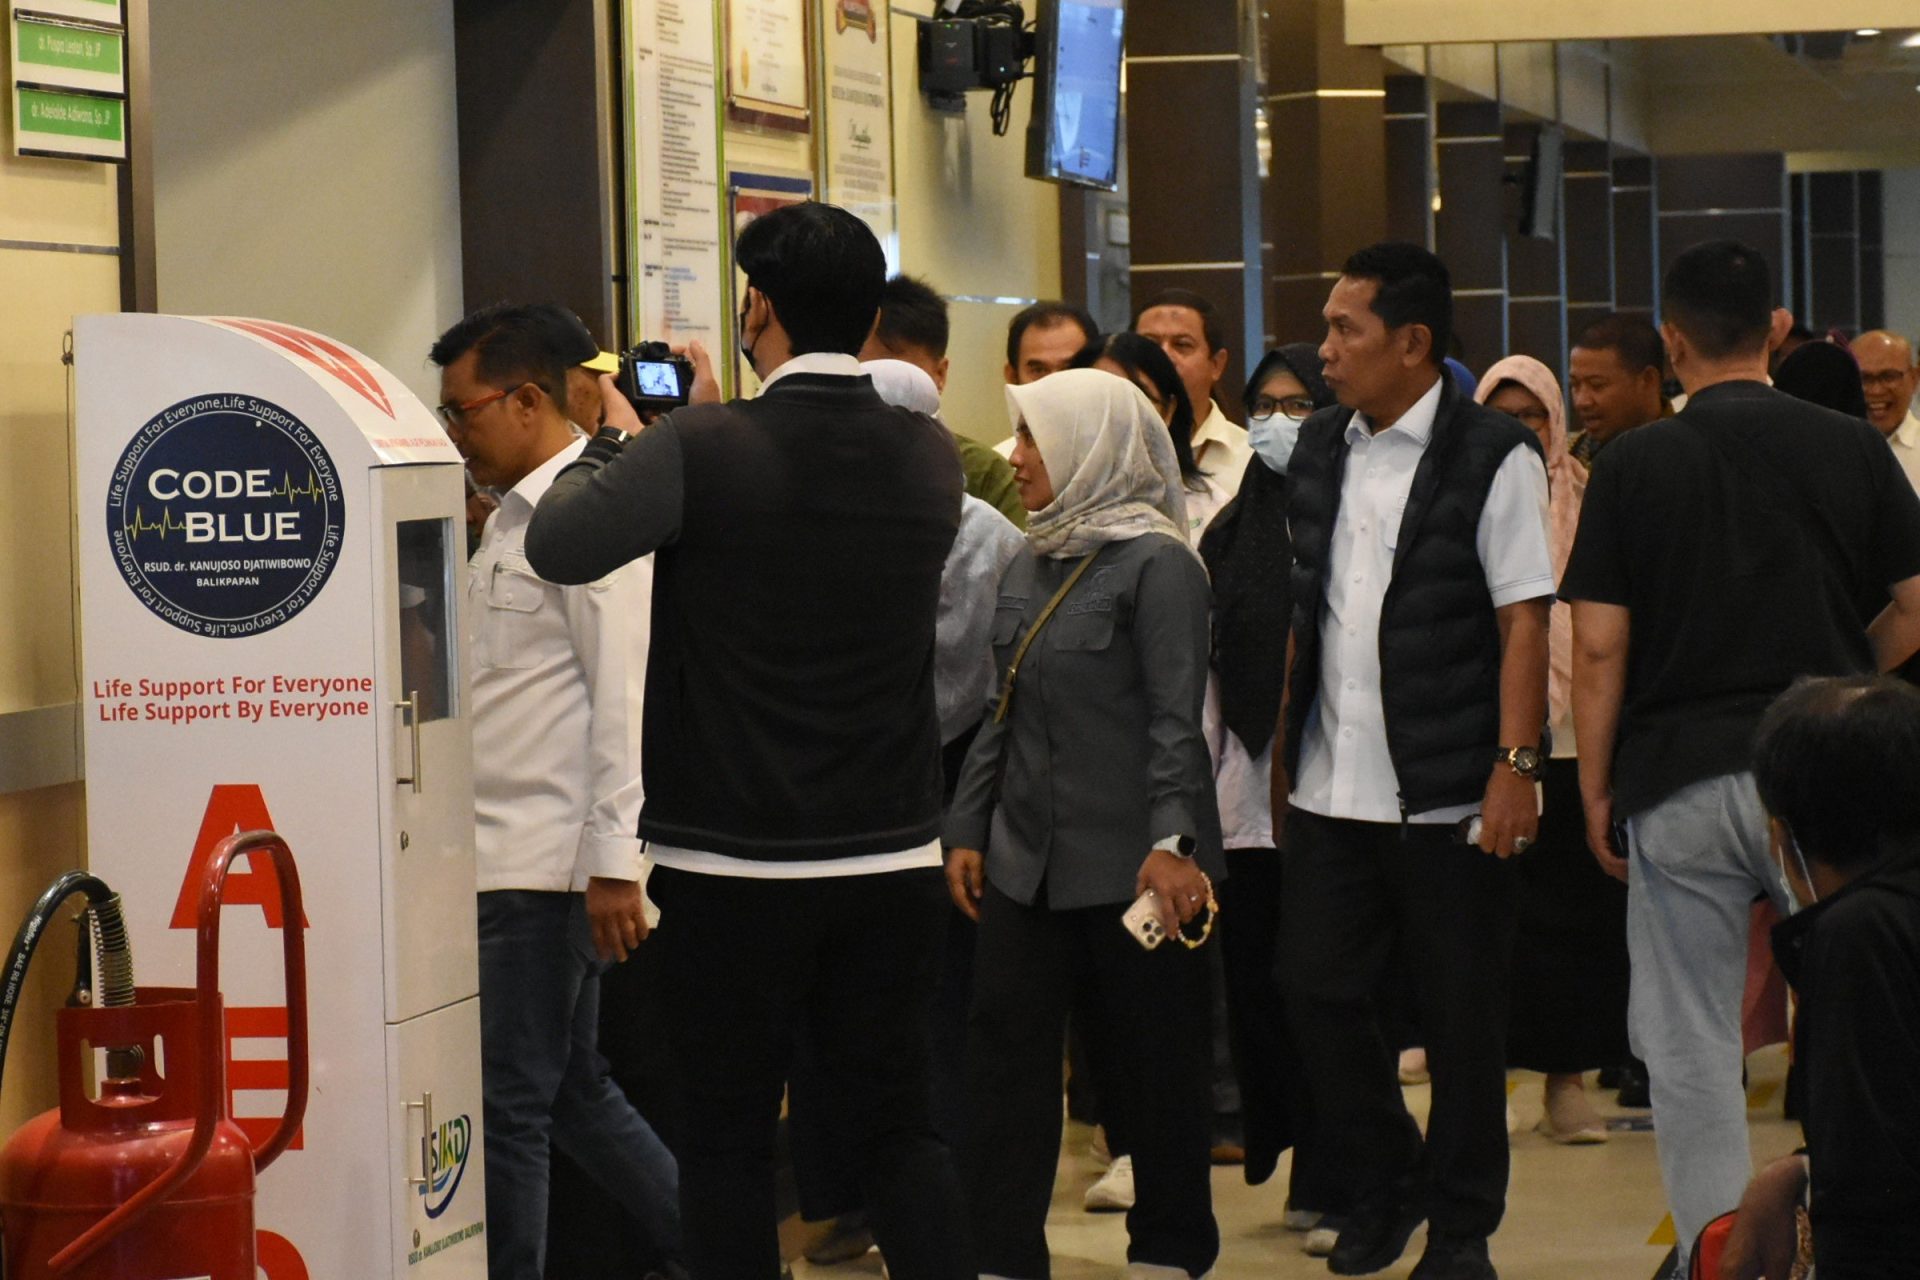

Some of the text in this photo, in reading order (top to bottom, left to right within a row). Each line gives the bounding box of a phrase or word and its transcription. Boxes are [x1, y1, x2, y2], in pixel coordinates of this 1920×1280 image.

[248, 399, 296, 431] Support
[144, 419, 165, 438] For
[294, 426, 313, 445] For
[115, 435, 149, 482] Support
[148, 468, 271, 500] CODE
[310, 445, 339, 502] Everyone
[110, 484, 124, 507] Life
[185, 511, 302, 543] BLUE
[326, 524, 340, 547] Life
[113, 530, 142, 587] Everyone
[144, 558, 312, 573] RSUD. dr. KANUJOSO DJATIWIBOWO
[196, 577, 260, 587] BALIKPAPAN
[301, 550, 335, 596] Support
[138, 586, 157, 606] For
[286, 594, 306, 613] For
[155, 600, 202, 633] Support
[93, 675, 372, 700] Life Support For Everyone
[100, 699, 369, 724] Life Support By Everyone
